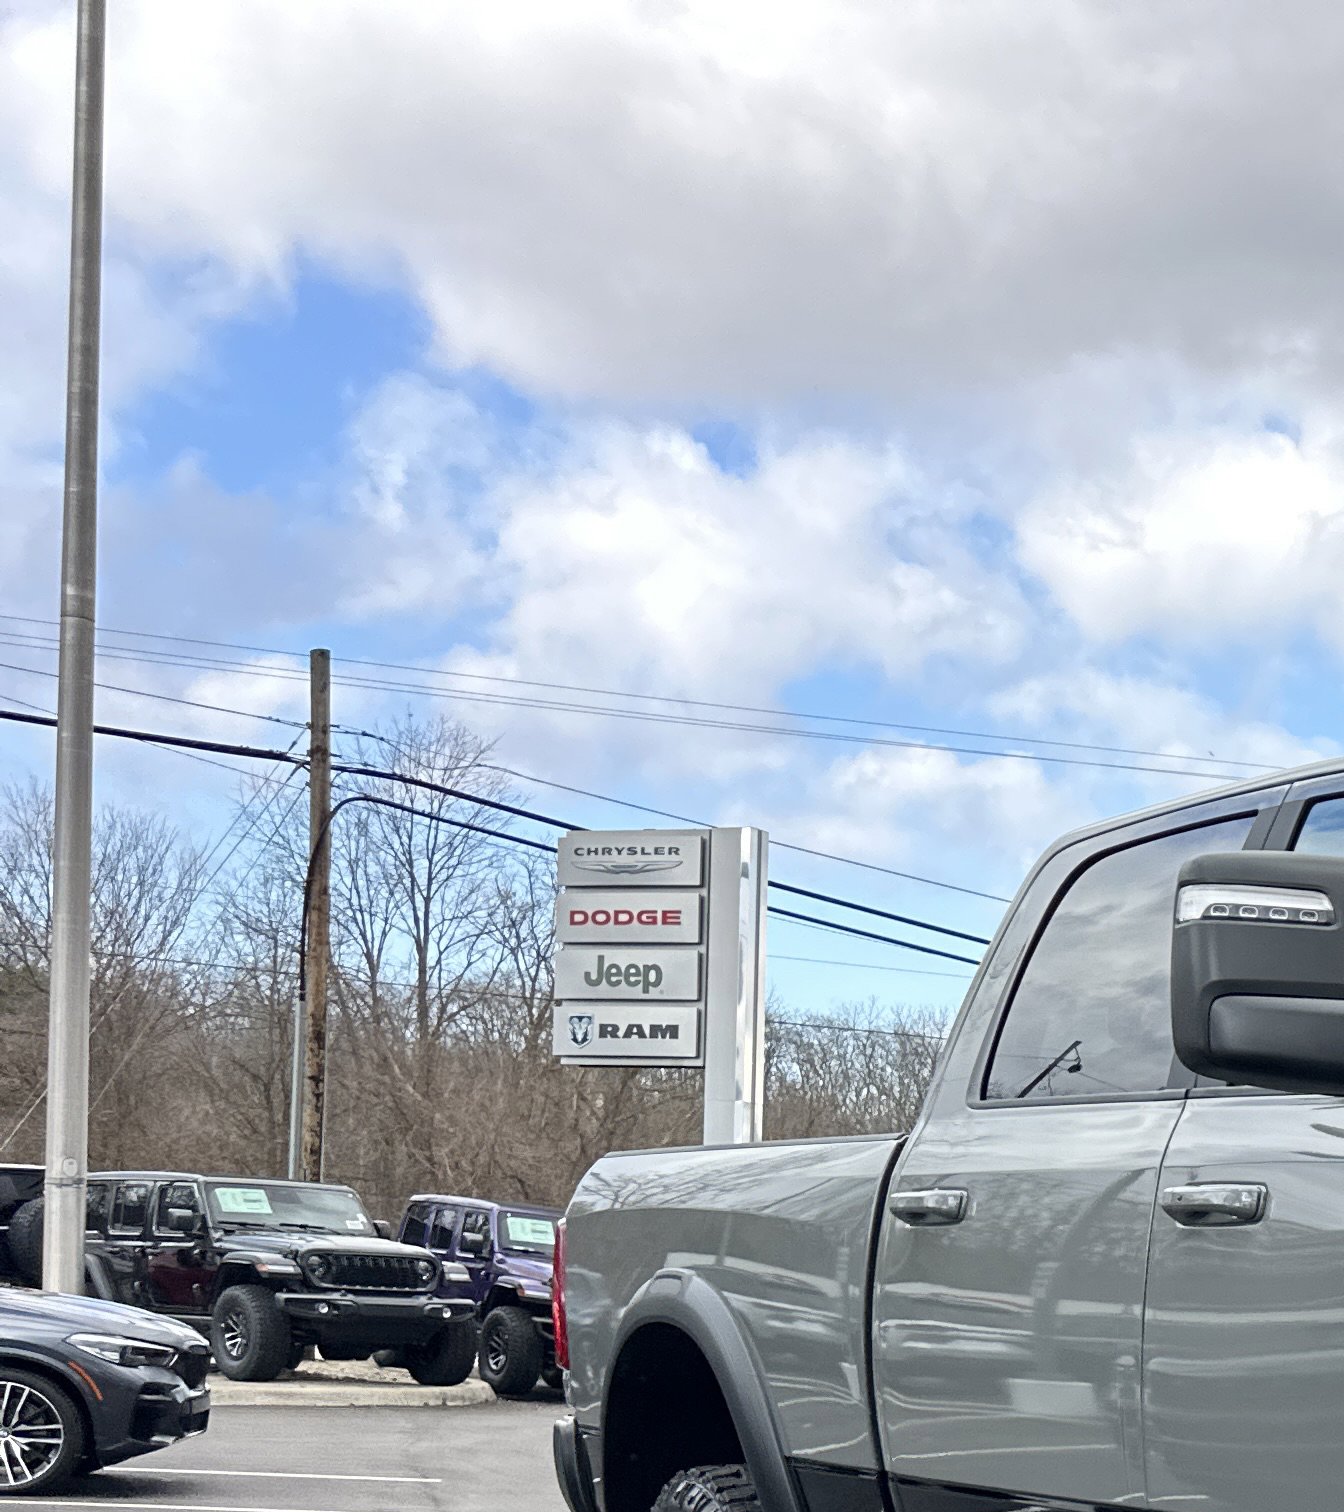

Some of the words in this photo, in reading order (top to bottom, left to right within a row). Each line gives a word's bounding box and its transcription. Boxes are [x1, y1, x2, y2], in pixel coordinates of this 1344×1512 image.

[573, 846, 681, 857] CHRYSLER
[569, 909, 682, 926] DODGE
[584, 954, 663, 994] Jeep
[598, 1023, 680, 1040] RAM
